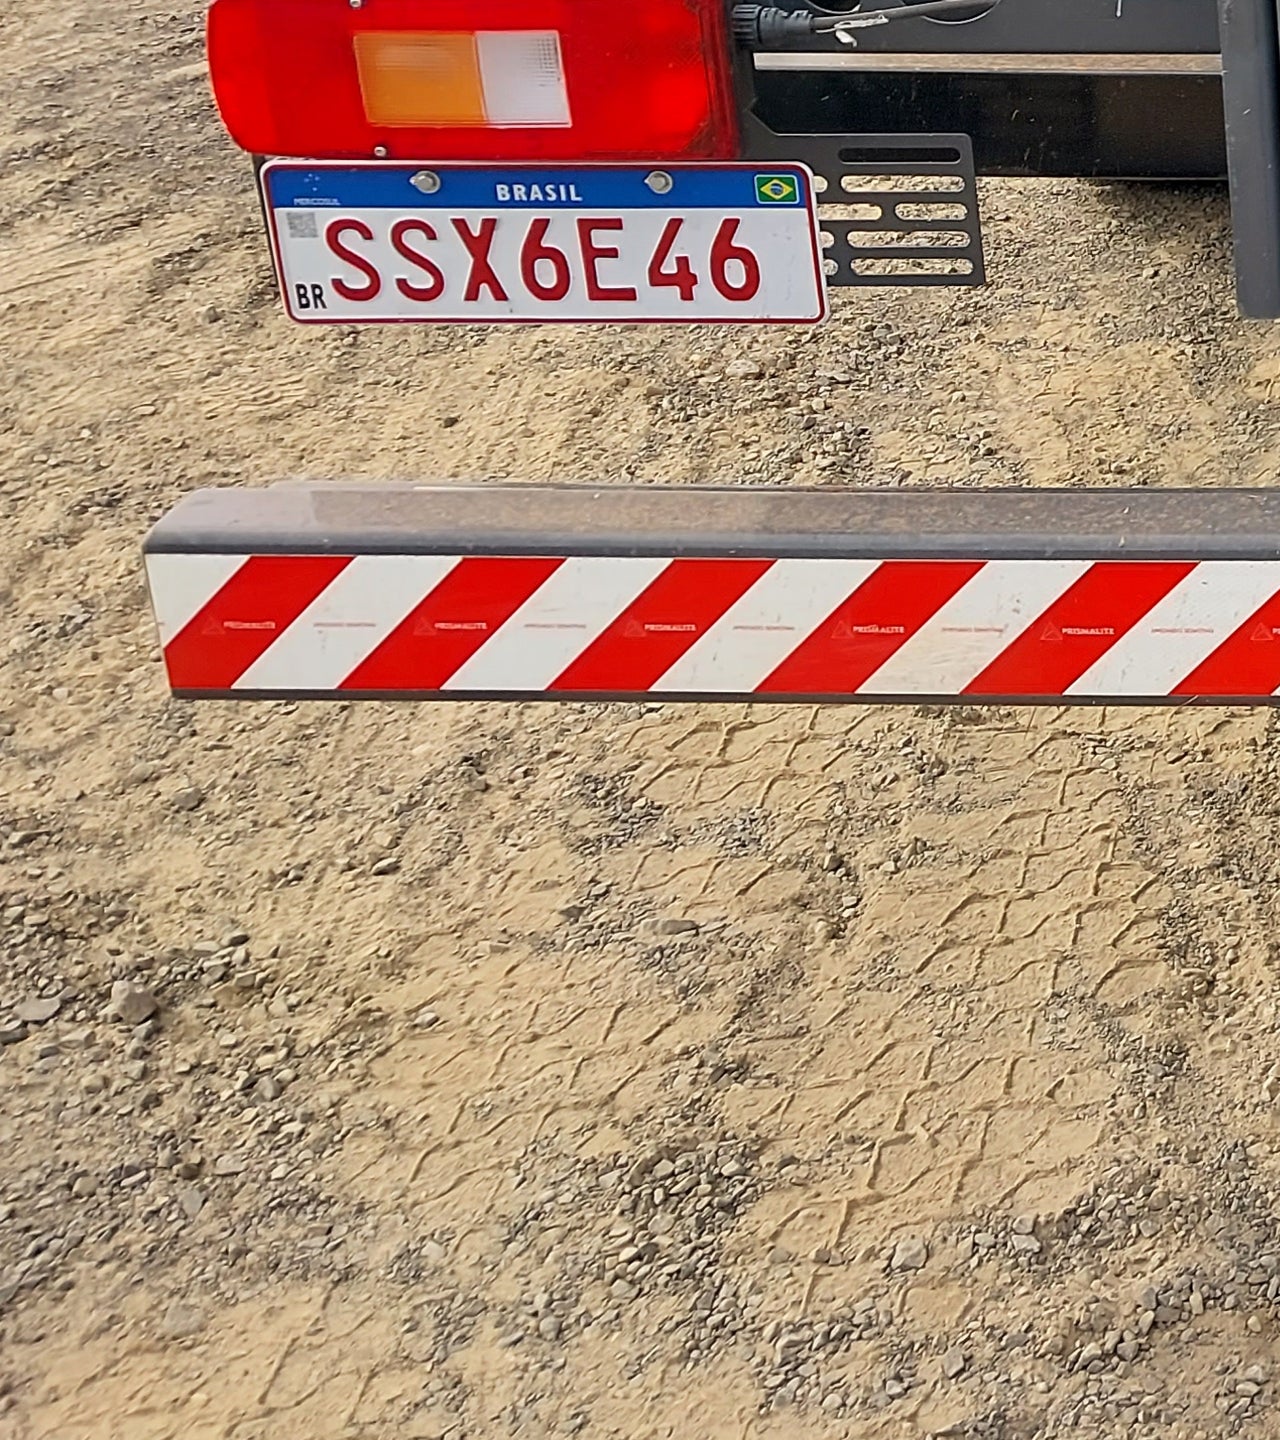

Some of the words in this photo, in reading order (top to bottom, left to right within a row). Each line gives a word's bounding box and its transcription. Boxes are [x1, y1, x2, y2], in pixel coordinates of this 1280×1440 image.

[496, 184, 583, 202] BRASIL
[326, 217, 761, 302] SSX6E46
[295, 283, 327, 310] BR
